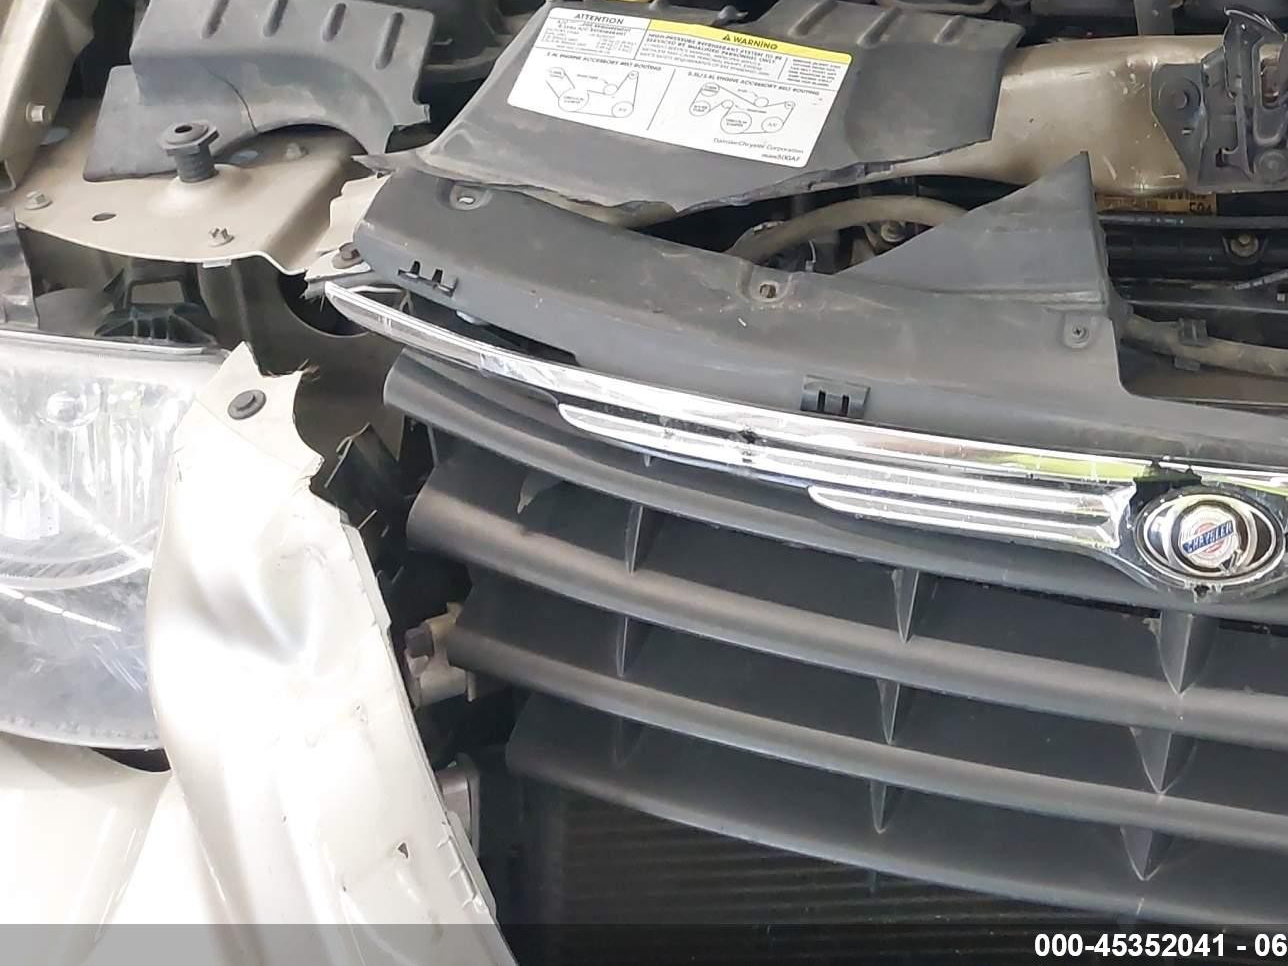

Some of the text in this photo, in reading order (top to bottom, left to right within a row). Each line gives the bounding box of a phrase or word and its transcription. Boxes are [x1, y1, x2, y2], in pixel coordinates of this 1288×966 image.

[574, 13, 624, 24] ATTENTION
[732, 35, 779, 51] WARNING
[1182, 520, 1234, 554] CHRYSLER
